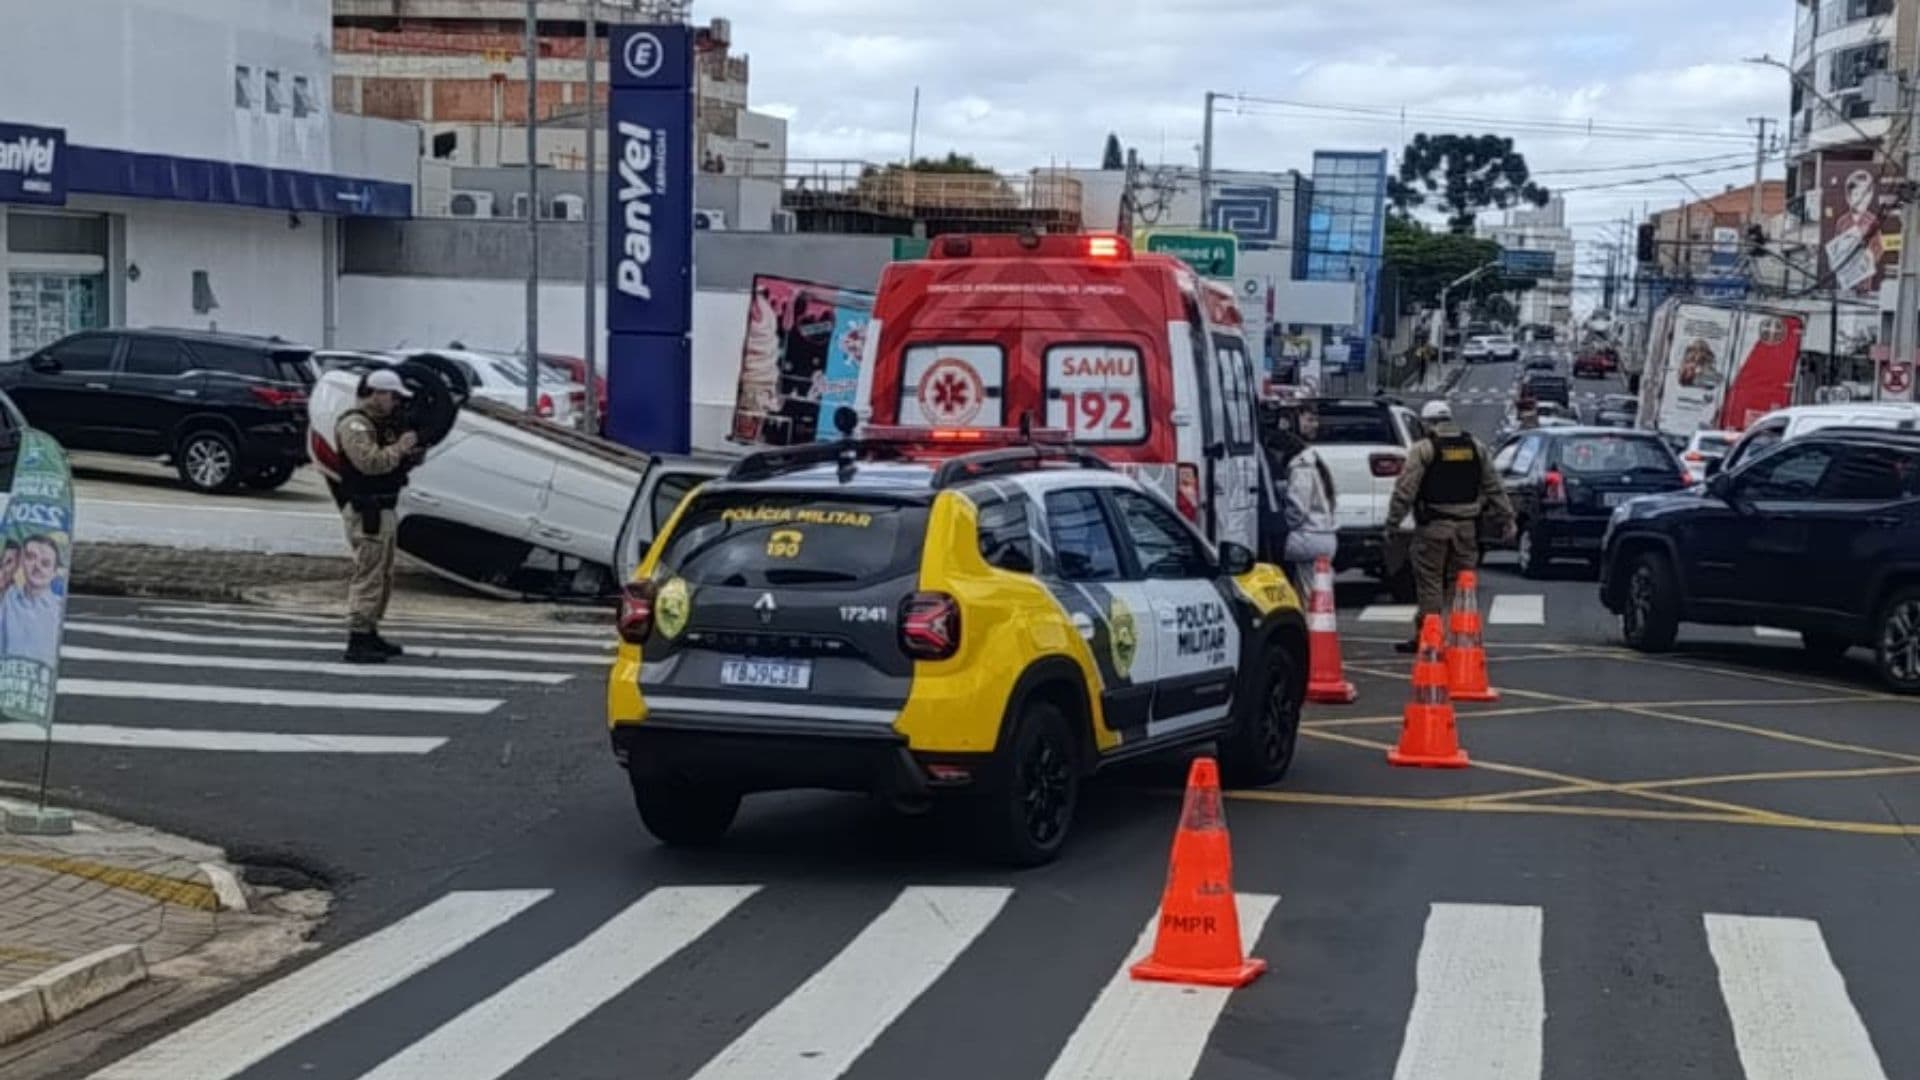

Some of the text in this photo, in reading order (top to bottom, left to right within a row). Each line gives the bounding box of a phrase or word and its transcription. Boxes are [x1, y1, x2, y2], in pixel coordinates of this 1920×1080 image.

[1062, 356, 1134, 377] SAMU
[1061, 391, 1133, 431] 192
[721, 504, 873, 528] POLÍCIA MILITAR
[767, 542, 800, 558] 190
[840, 606, 888, 622] 17241
[1177, 602, 1225, 629] POLÍCIA
[1177, 627, 1226, 657] MILITAR
[1163, 914, 1217, 935] PMPR
